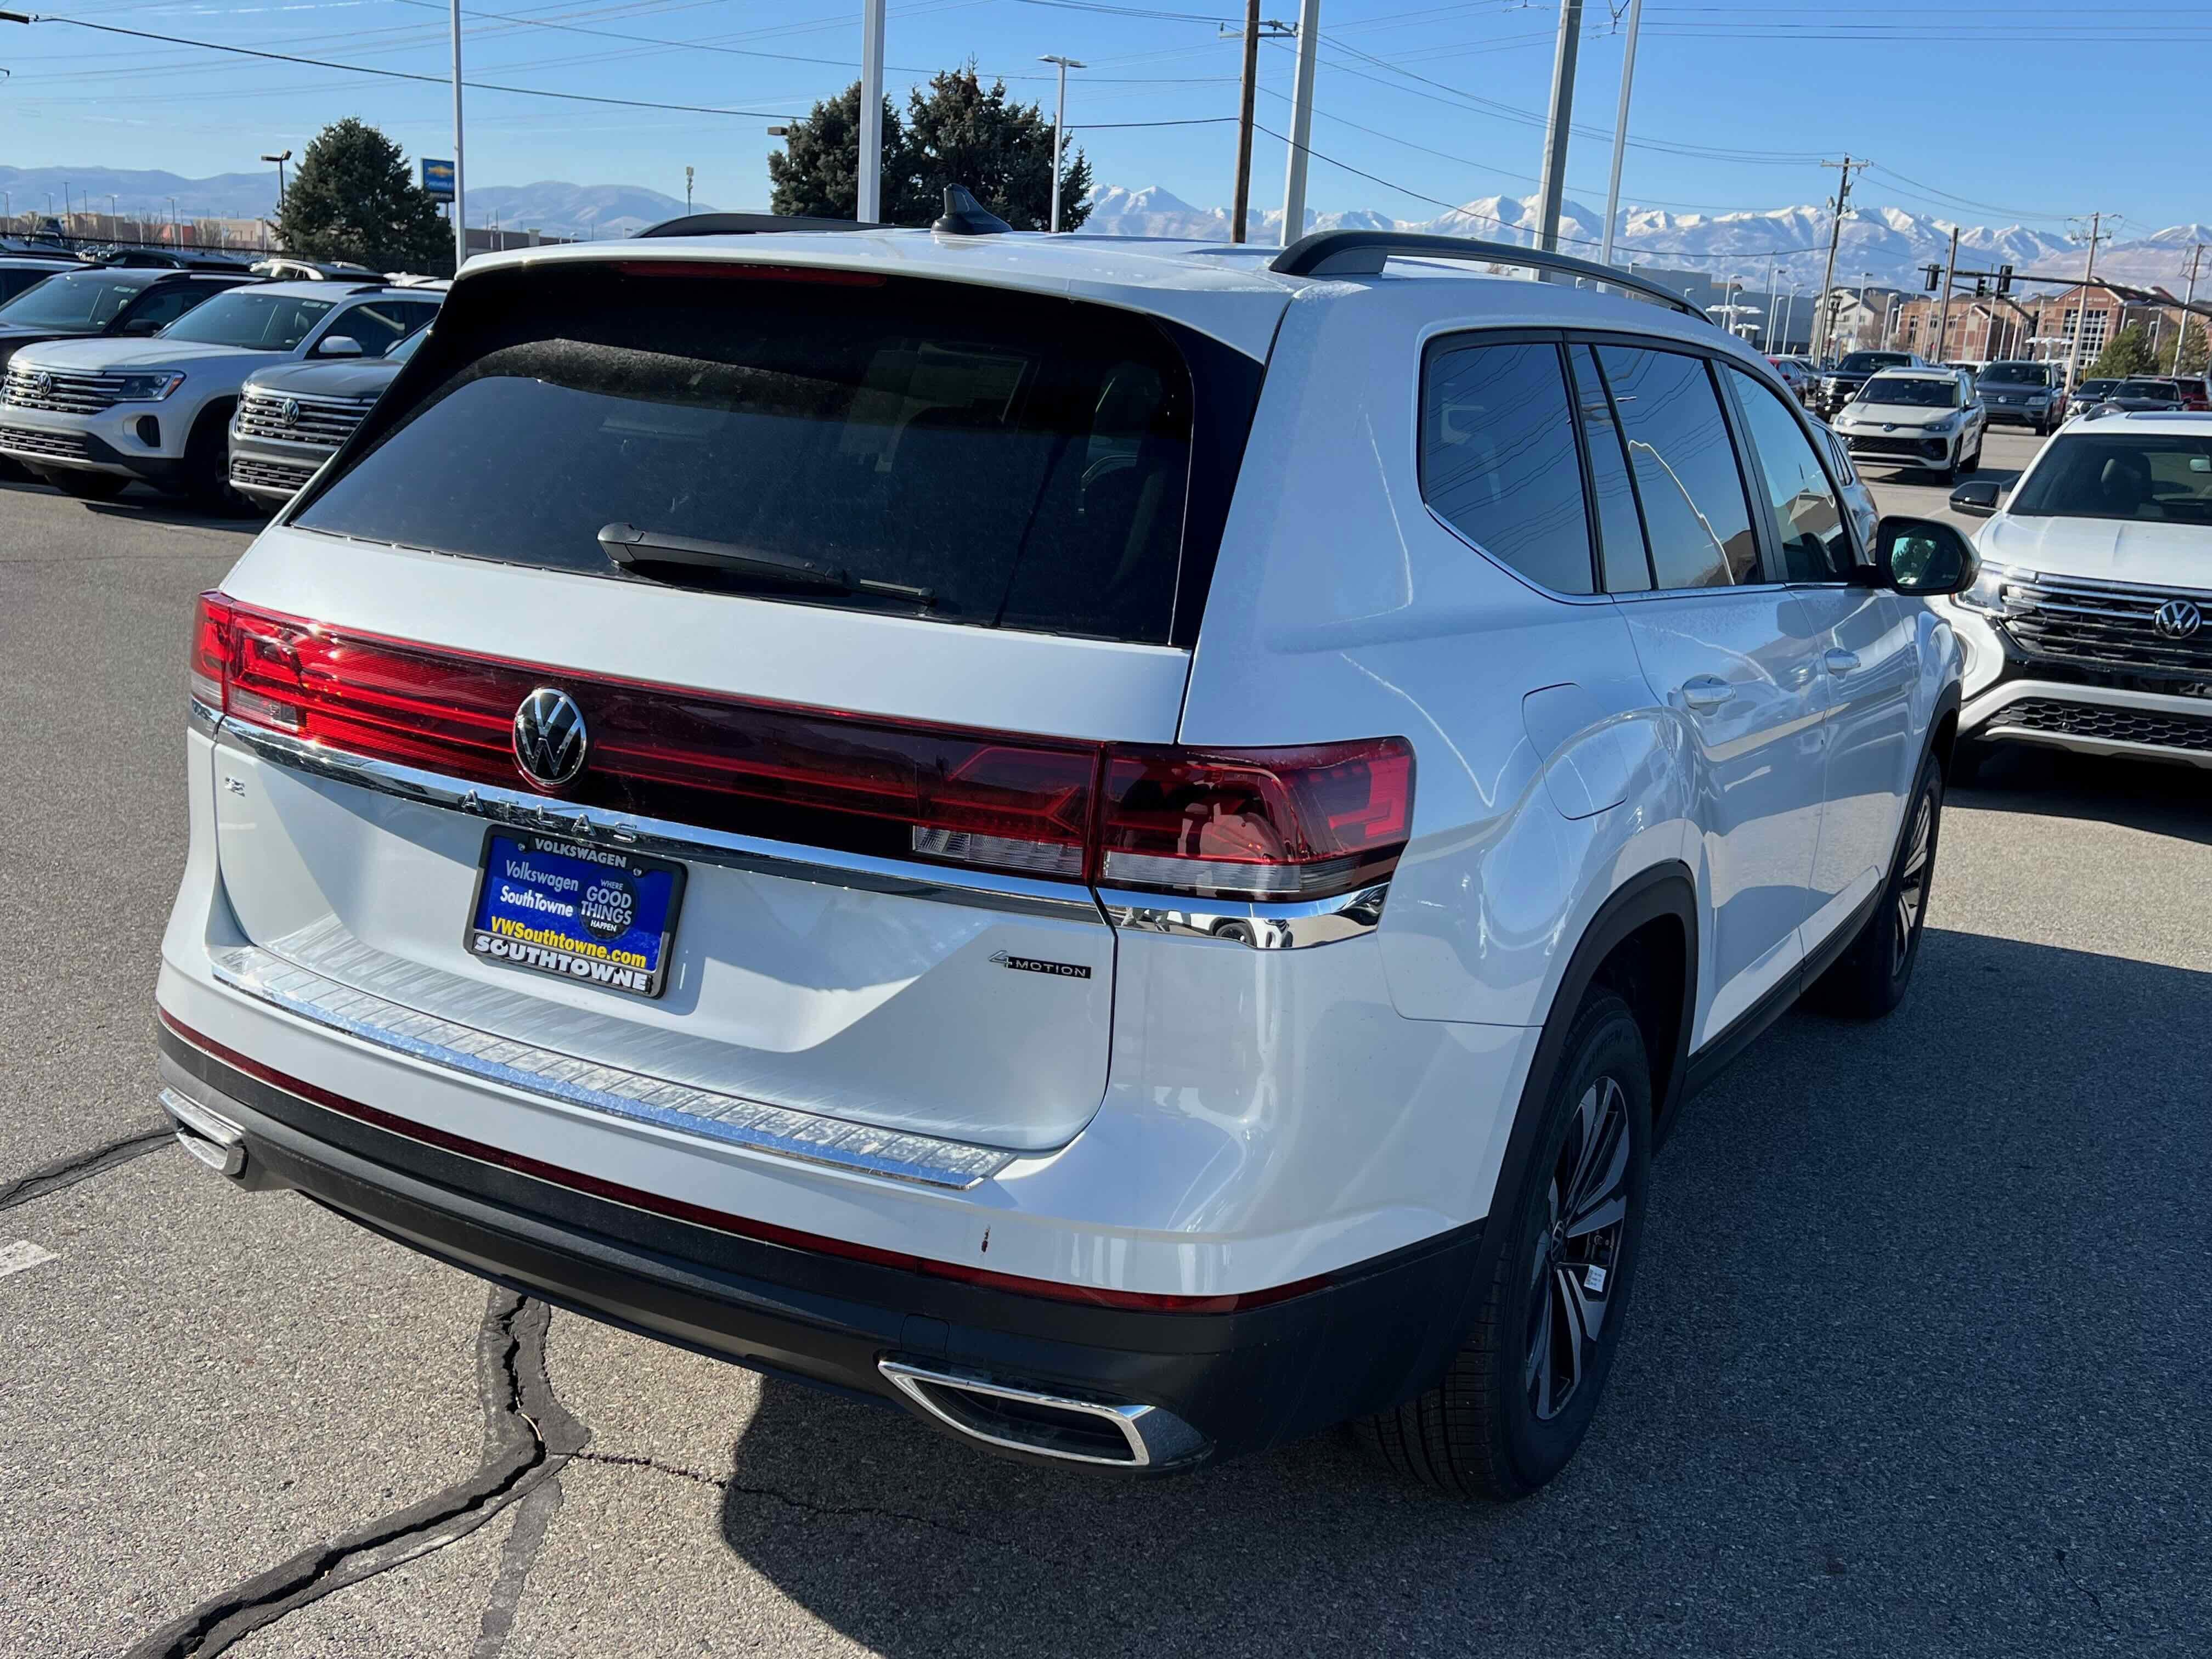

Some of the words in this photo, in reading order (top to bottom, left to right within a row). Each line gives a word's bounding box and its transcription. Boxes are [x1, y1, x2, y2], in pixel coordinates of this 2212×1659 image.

[2156, 600, 2200, 639] VW
[514, 688, 586, 784] VW
[461, 789, 637, 843] ATLAS
[535, 838, 627, 867] VOLKSWAGEN
[506, 860, 579, 892] Volkswagen
[601, 879, 624, 890] WHERE
[500, 885, 574, 917] SouthTowne
[582, 900, 632, 926] THINGS
[586, 886, 632, 909] GOOD
[590, 919, 617, 932] HAPPEN
[491, 916, 647, 968] VWSouthtowne.com
[475, 935, 649, 991] SOUTHTOWNE
